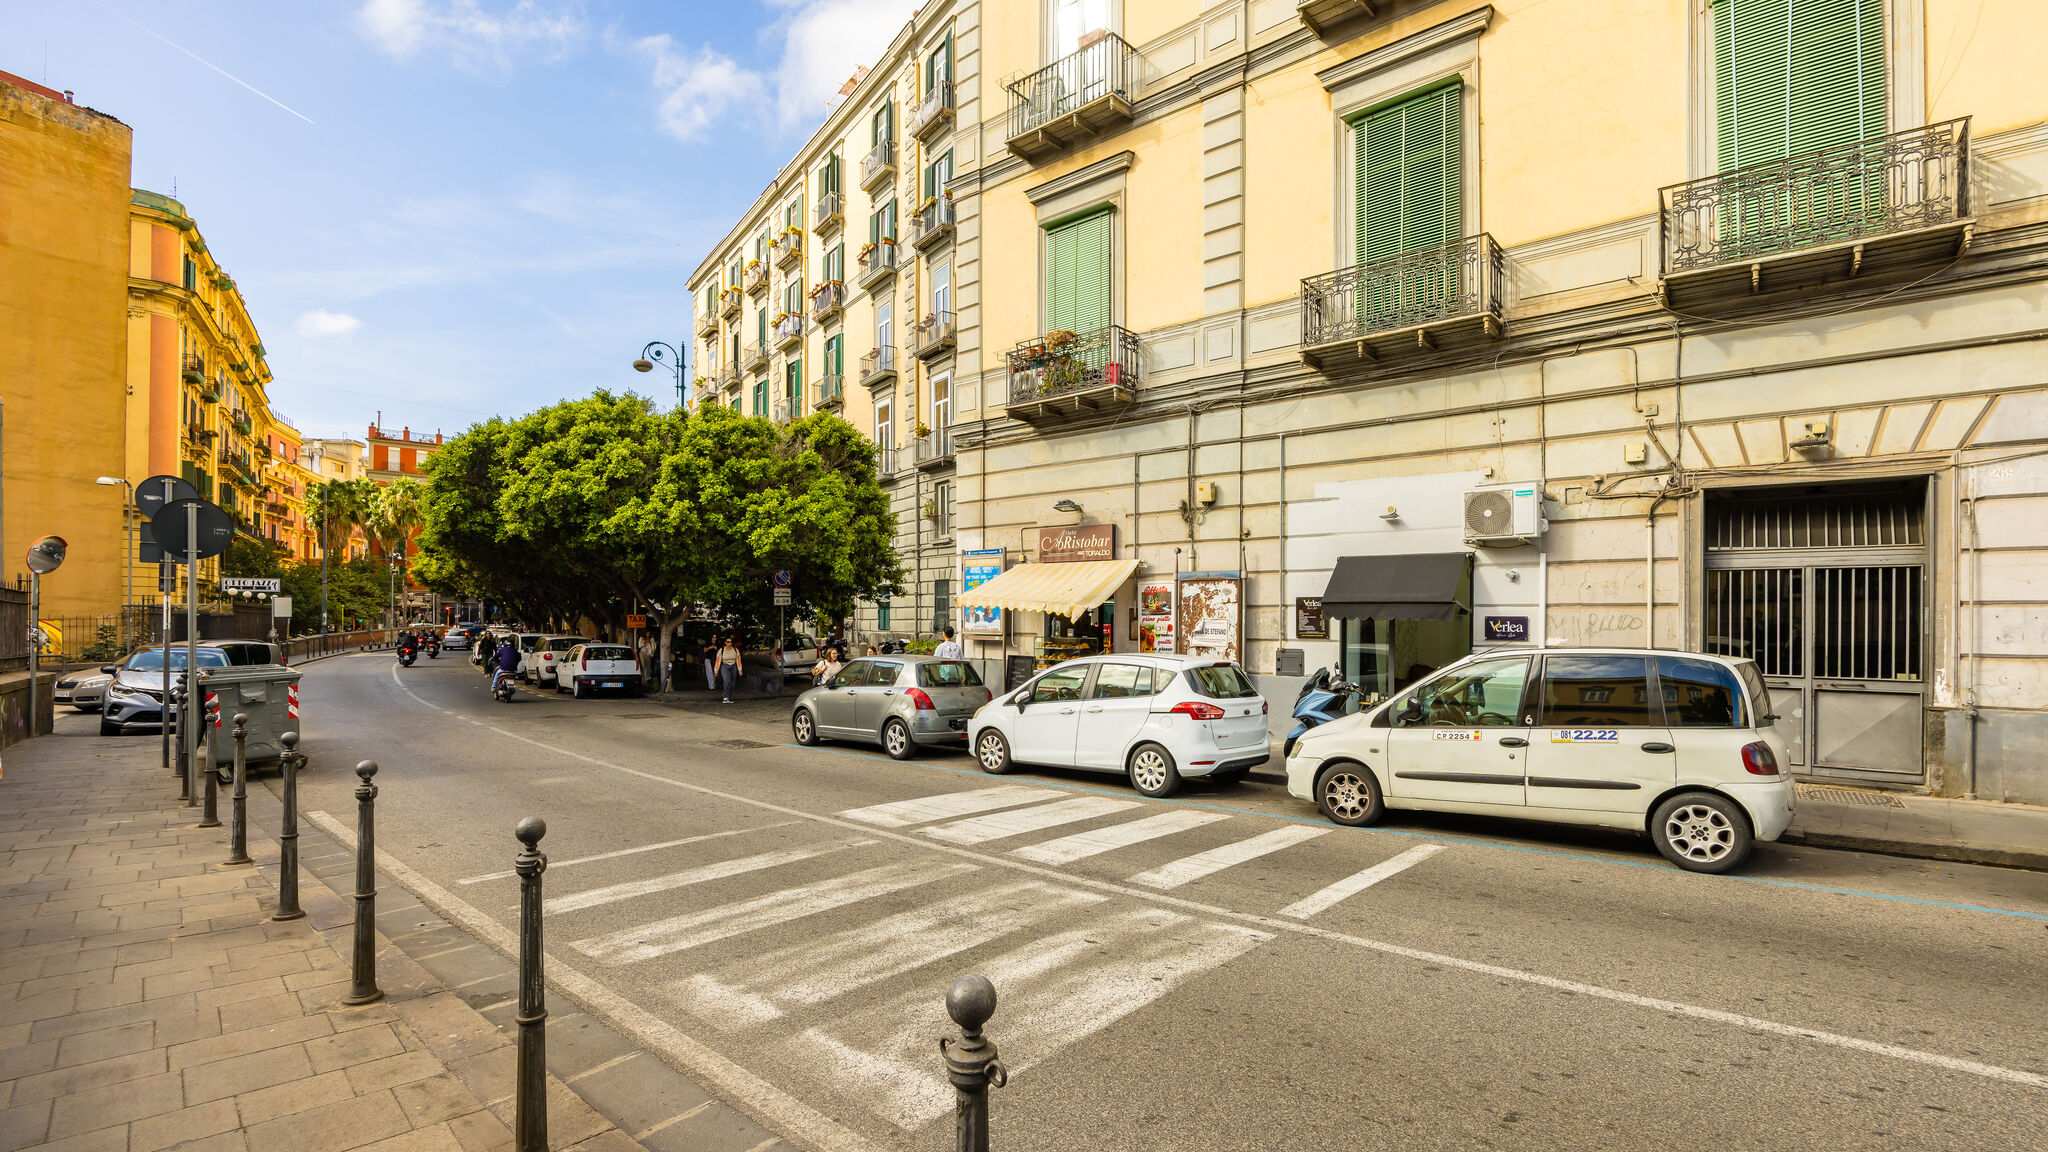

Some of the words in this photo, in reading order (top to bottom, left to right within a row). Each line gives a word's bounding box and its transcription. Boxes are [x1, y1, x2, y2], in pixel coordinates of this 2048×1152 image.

[628, 615, 646, 623] TAXI
[1489, 619, 1524, 633] Verlea
[1525, 714, 1533, 726] 6
